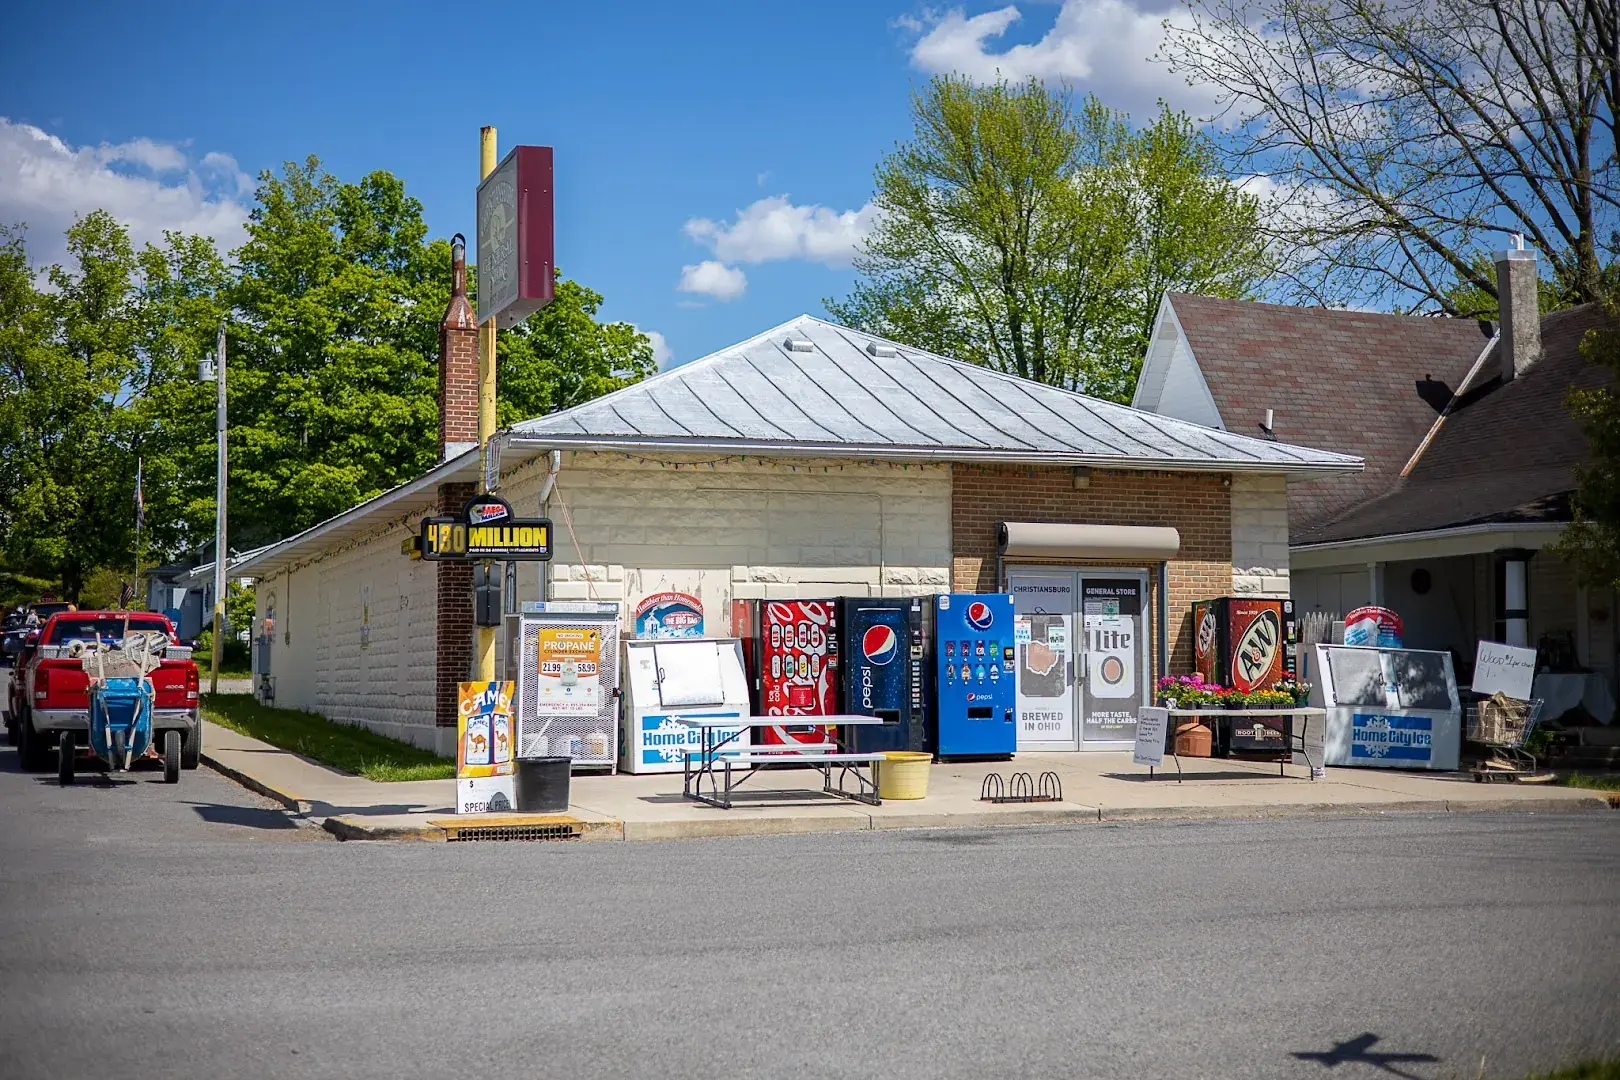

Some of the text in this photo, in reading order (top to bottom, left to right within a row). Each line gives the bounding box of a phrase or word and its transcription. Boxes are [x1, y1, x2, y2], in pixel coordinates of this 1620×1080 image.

[482, 505, 504, 515] MEGA
[469, 527, 547, 547] MILLION
[676, 616, 686, 624] BIG
[544, 641, 595, 650] PROPANE
[1095, 630, 1131, 652] Lite
[1240, 614, 1274, 682] A&W
[542, 663, 596, 672] 21.99 58.99
[861, 666, 873, 708] pepsi
[460, 690, 515, 715] CAMEL
[1022, 712, 1063, 721] BREWED
[469, 720, 488, 729] CAMEL
[1025, 722, 1061, 730] IN OHIO
[643, 732, 685, 745] Home
[718, 730, 739, 742] Ice
[1353, 728, 1431, 746] Home City Ice
[464, 800, 493, 813] SPECIAL
